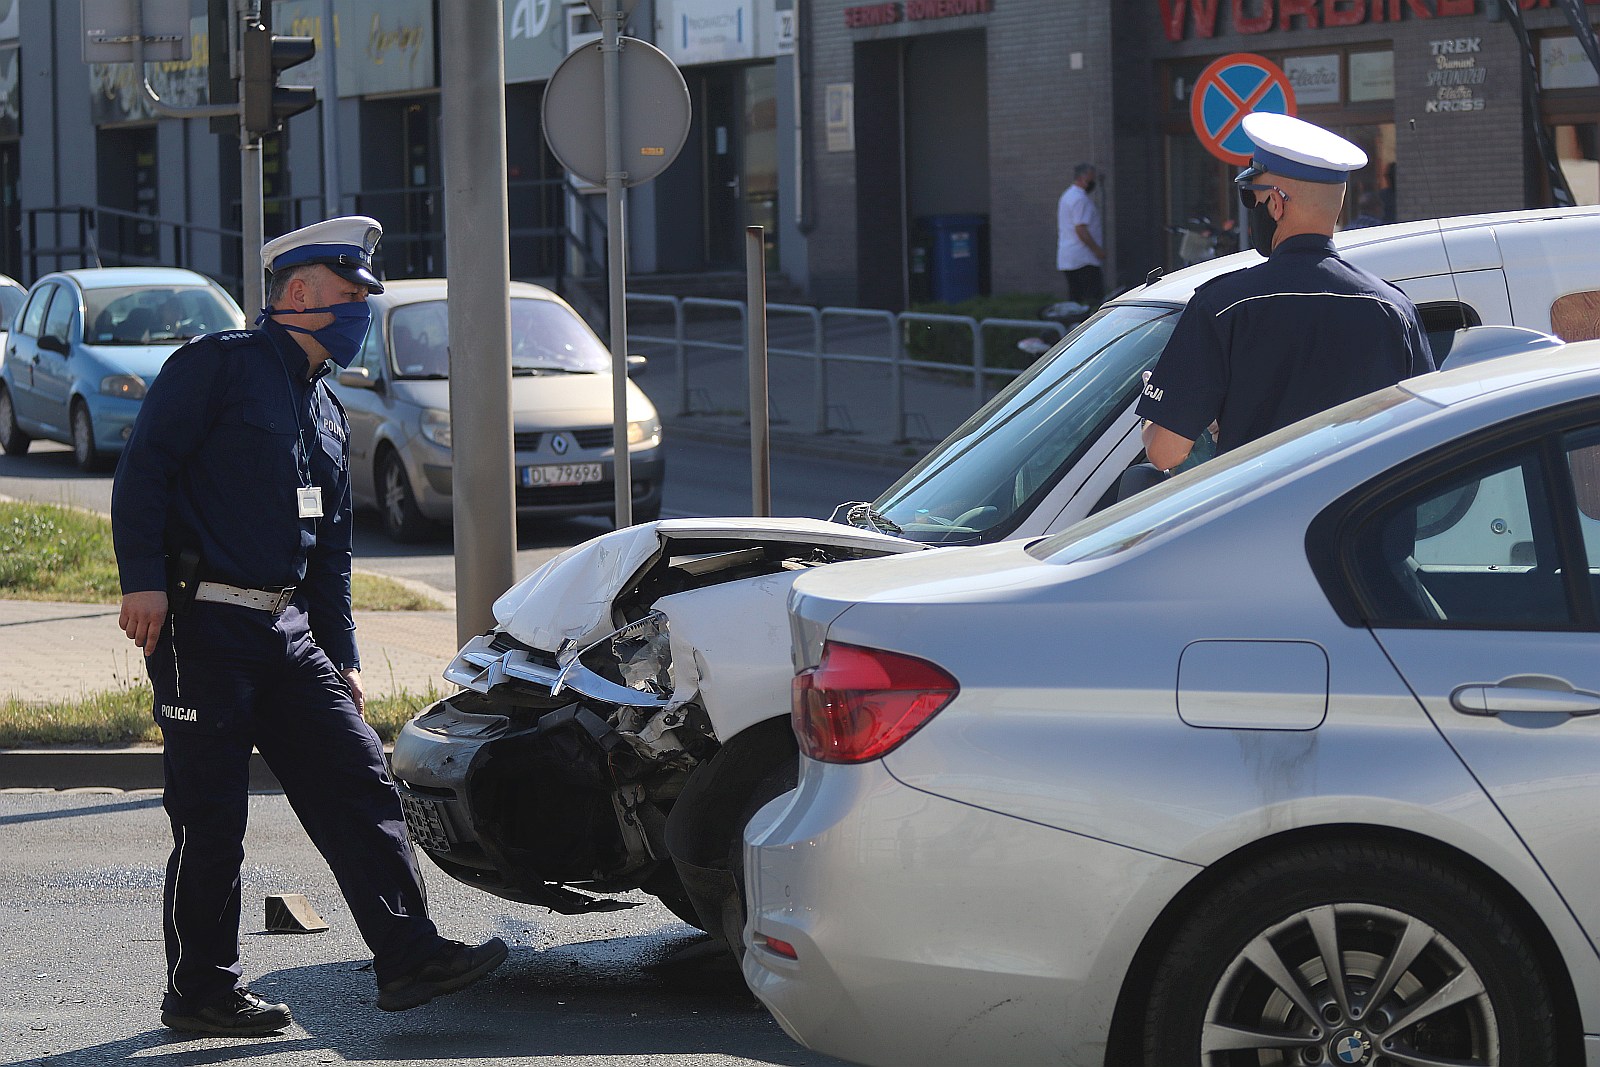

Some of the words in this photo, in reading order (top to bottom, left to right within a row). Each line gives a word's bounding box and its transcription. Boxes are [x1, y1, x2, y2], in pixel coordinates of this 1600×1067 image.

[1429, 37, 1481, 55] TREK
[1425, 98, 1485, 113] KROSS
[532, 468, 551, 484] DL
[556, 466, 599, 481] 79696
[161, 704, 198, 722] POLICJA
